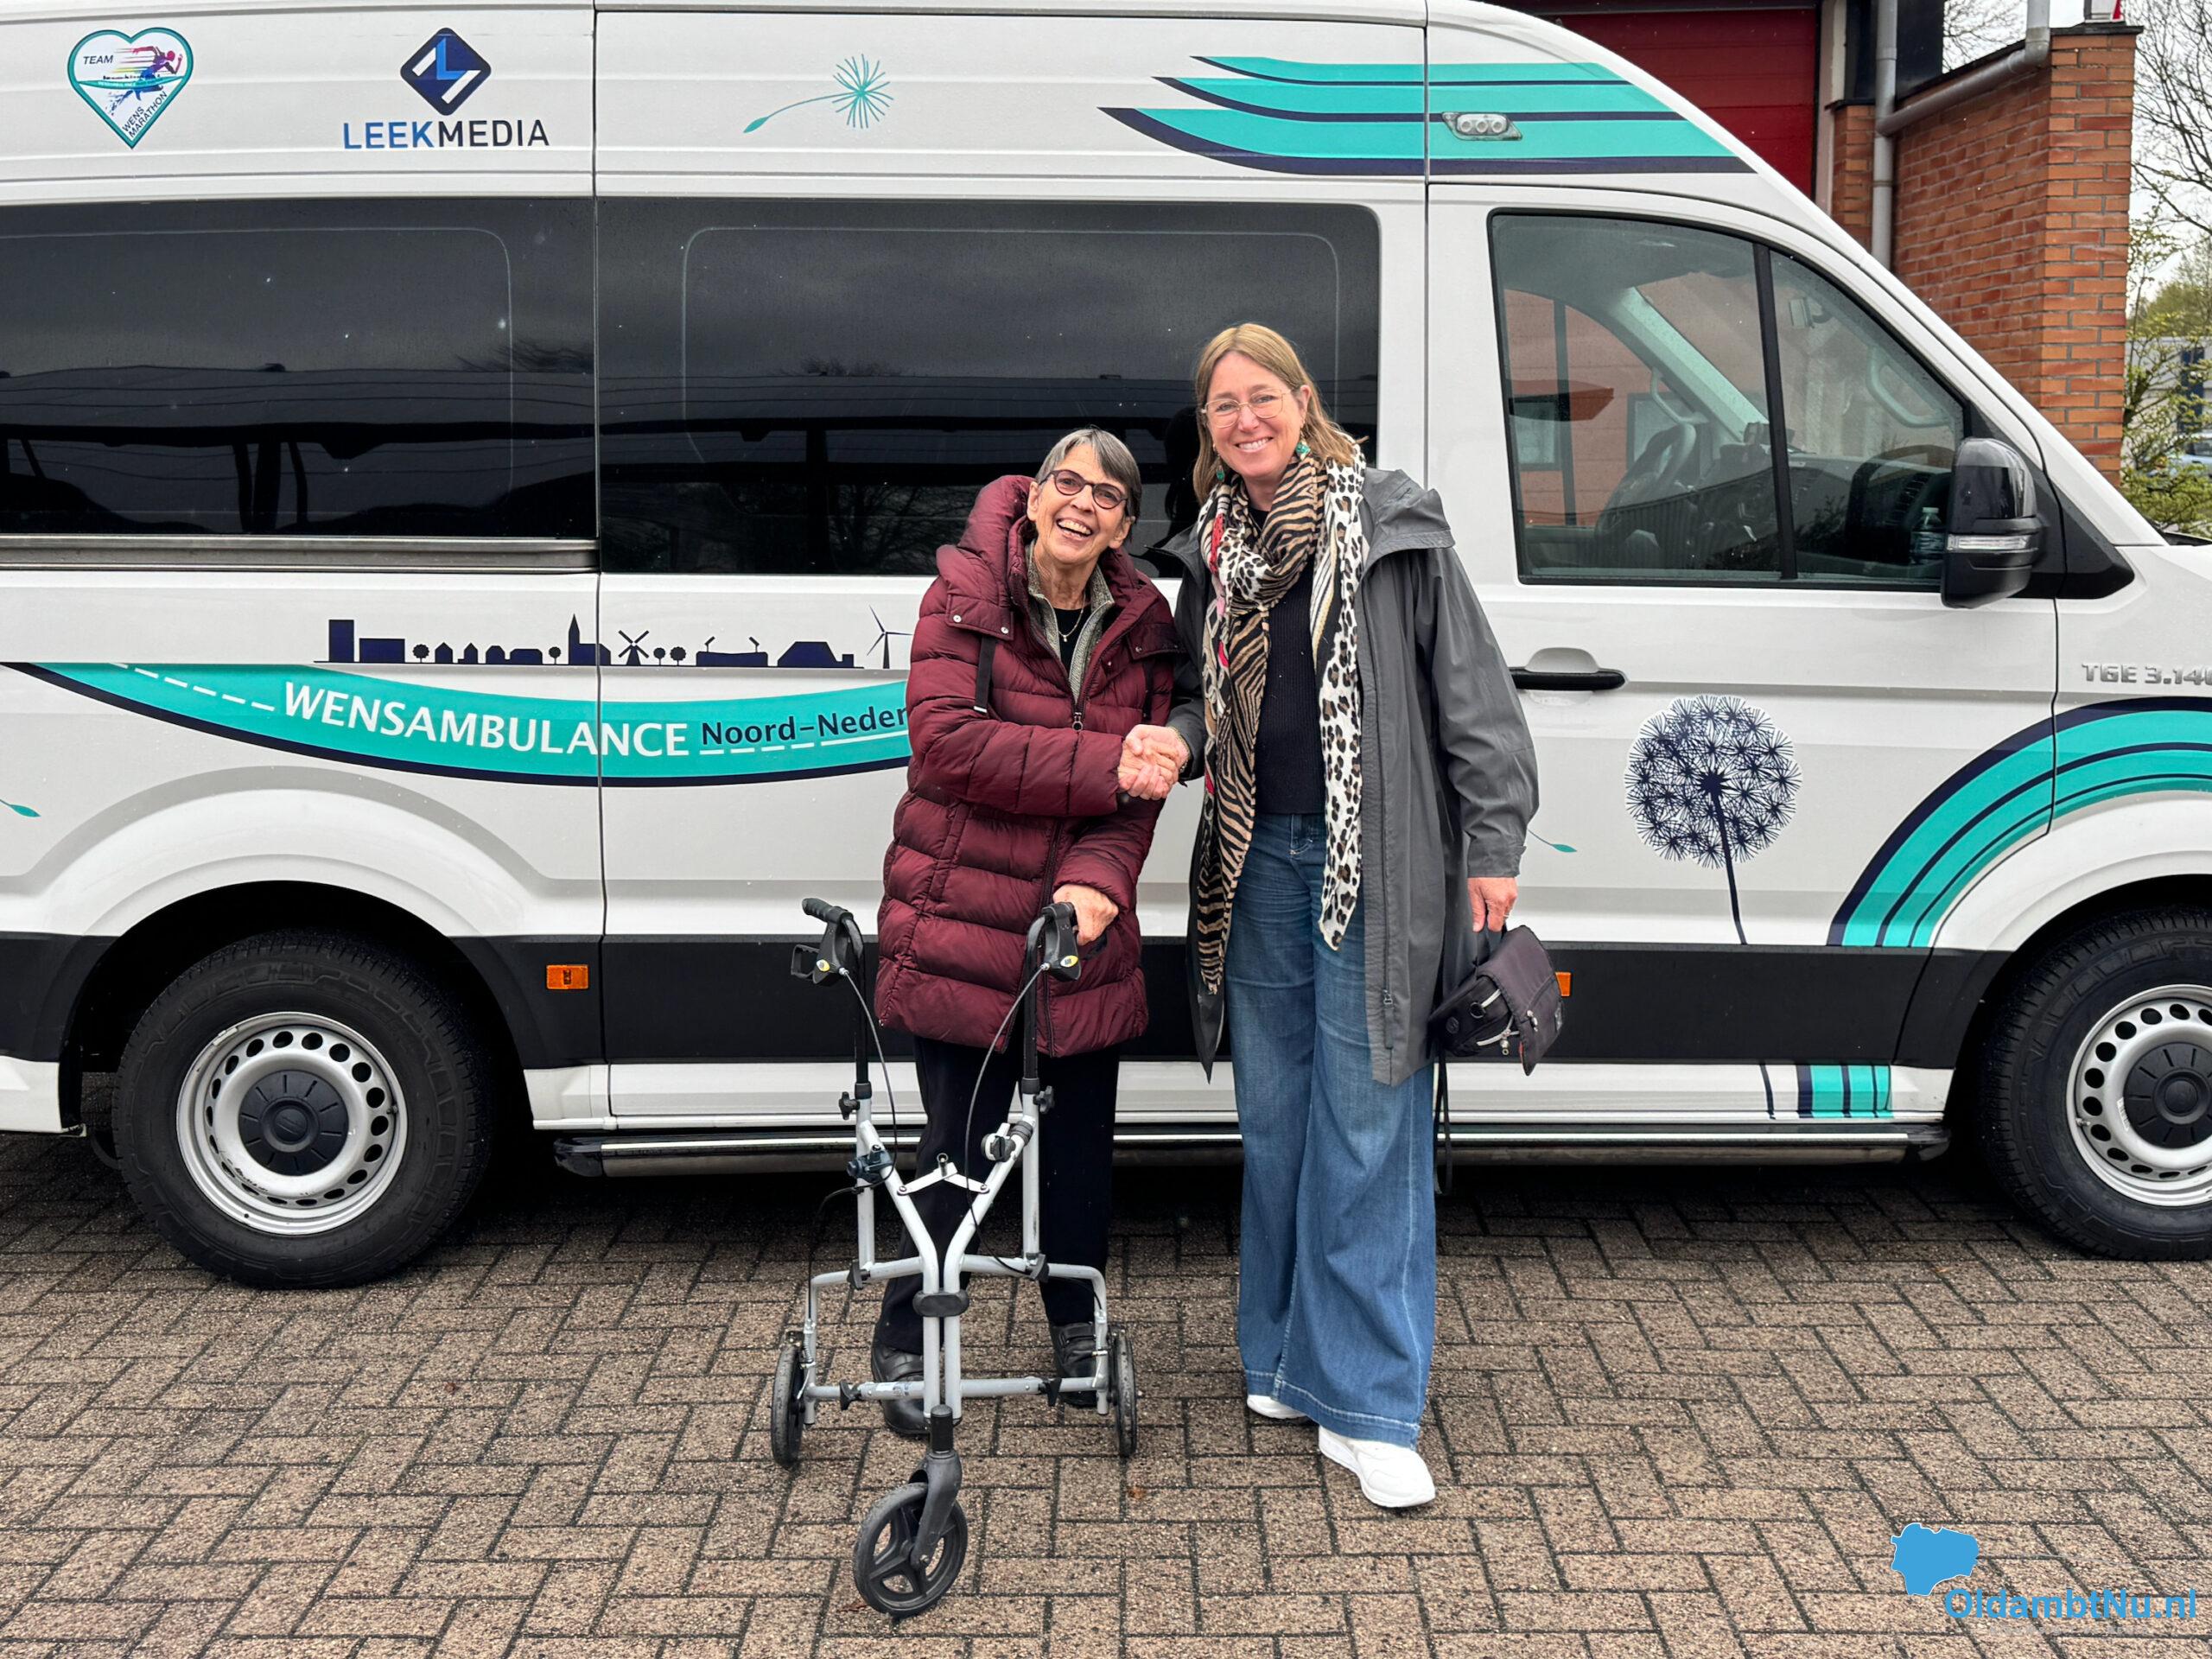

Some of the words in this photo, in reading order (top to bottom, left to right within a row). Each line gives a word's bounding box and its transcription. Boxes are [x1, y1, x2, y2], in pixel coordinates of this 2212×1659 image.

[83, 55, 114, 65] TEAM
[122, 106, 144, 132] WENS
[129, 92, 168, 137] MARATHON
[343, 119, 550, 149] LEEKMEDIA
[2082, 664, 2137, 683] TGE
[285, 681, 689, 757] WENSAMBULANCE
